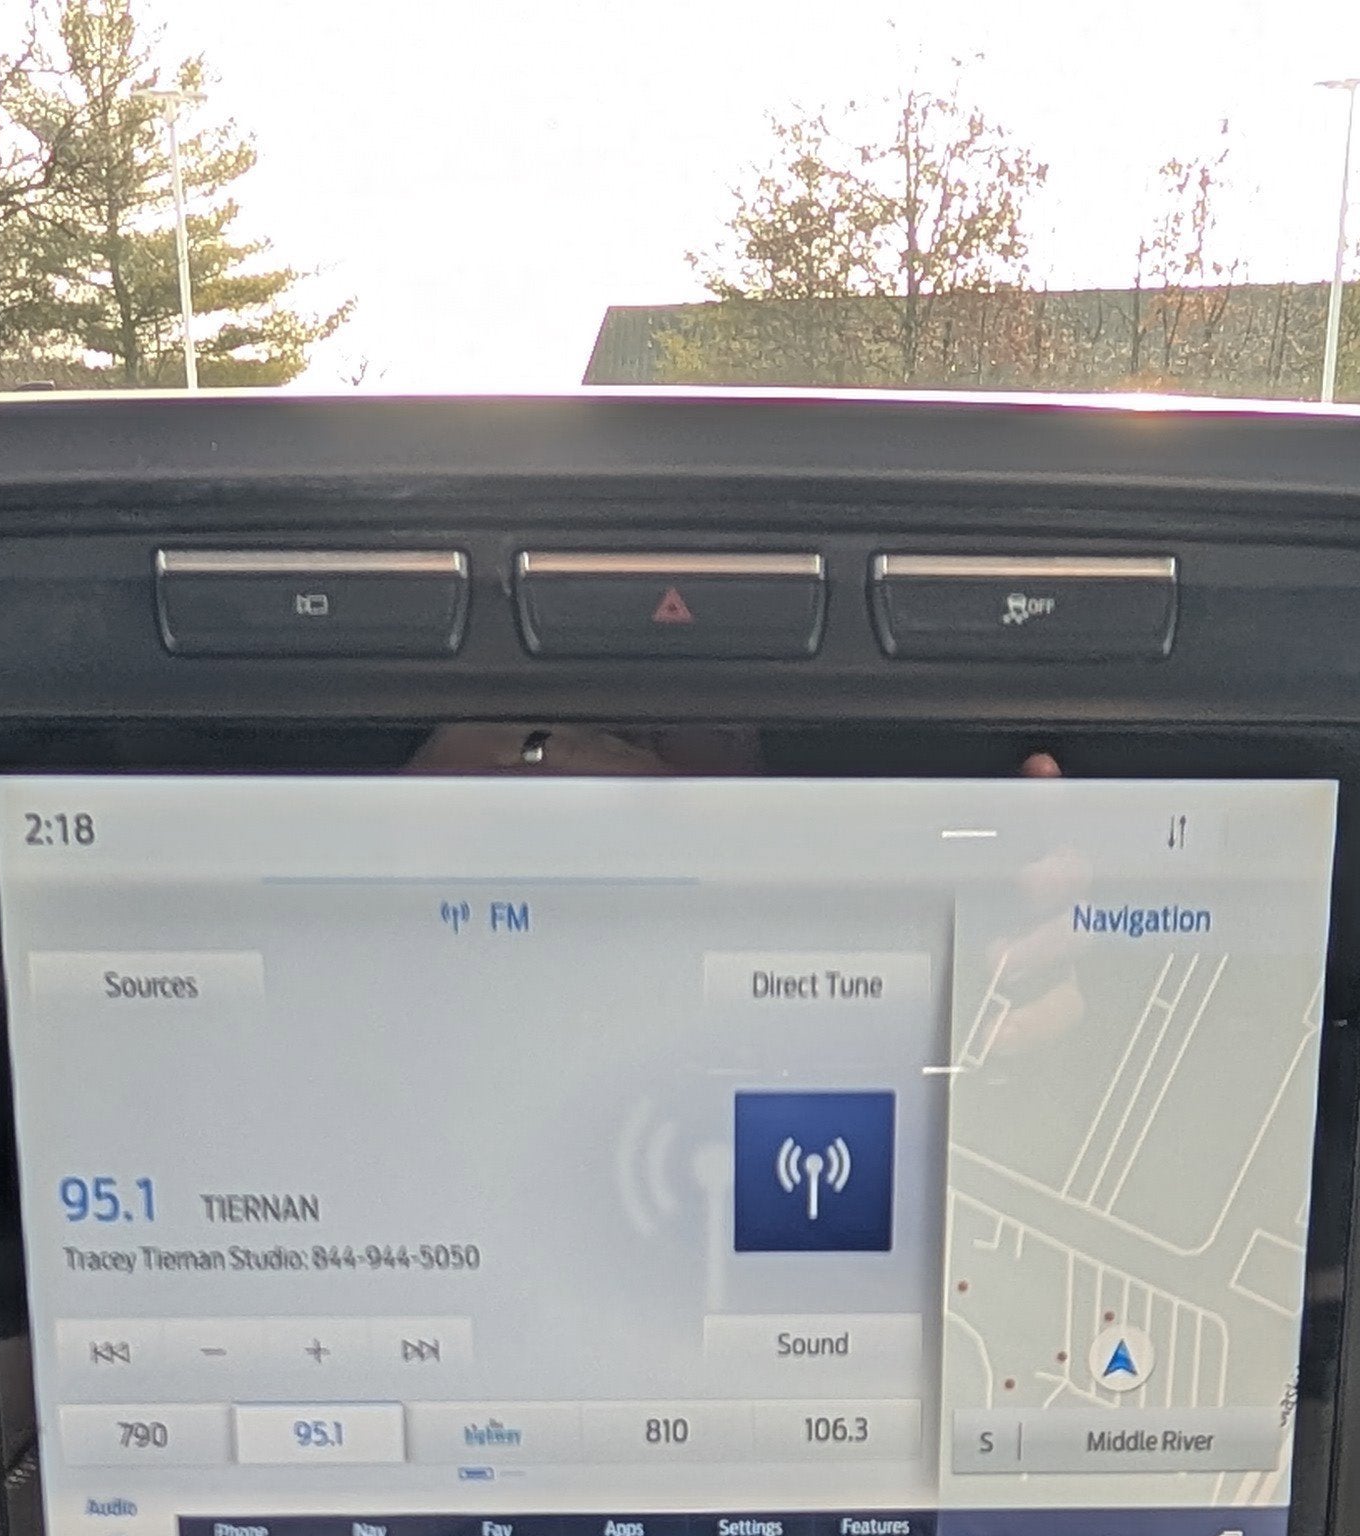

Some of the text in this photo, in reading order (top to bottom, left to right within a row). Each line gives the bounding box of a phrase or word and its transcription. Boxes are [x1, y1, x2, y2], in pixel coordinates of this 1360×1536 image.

[1027, 598, 1056, 614] OFF
[24, 813, 95, 846] 2:18
[490, 902, 529, 932] FM
[1073, 905, 1211, 937] Navigation
[104, 972, 198, 999] Sources
[752, 972, 883, 999] Direct Tune
[59, 1177, 320, 1222] 95.1 TIERNAN
[63, 1243, 481, 1274] Tracey Tiernan Studio: 844-944-5050
[777, 1332, 849, 1356] Sound
[119, 1422, 168, 1448] 790
[293, 1421, 343, 1446] 95.1
[645, 1419, 689, 1443] 810
[804, 1417, 868, 1443] 106.3
[979, 1431, 994, 1453] S
[1087, 1429, 1214, 1453] Middle River
[85, 1499, 139, 1517] Audio
[841, 1517, 911, 1536] Features
